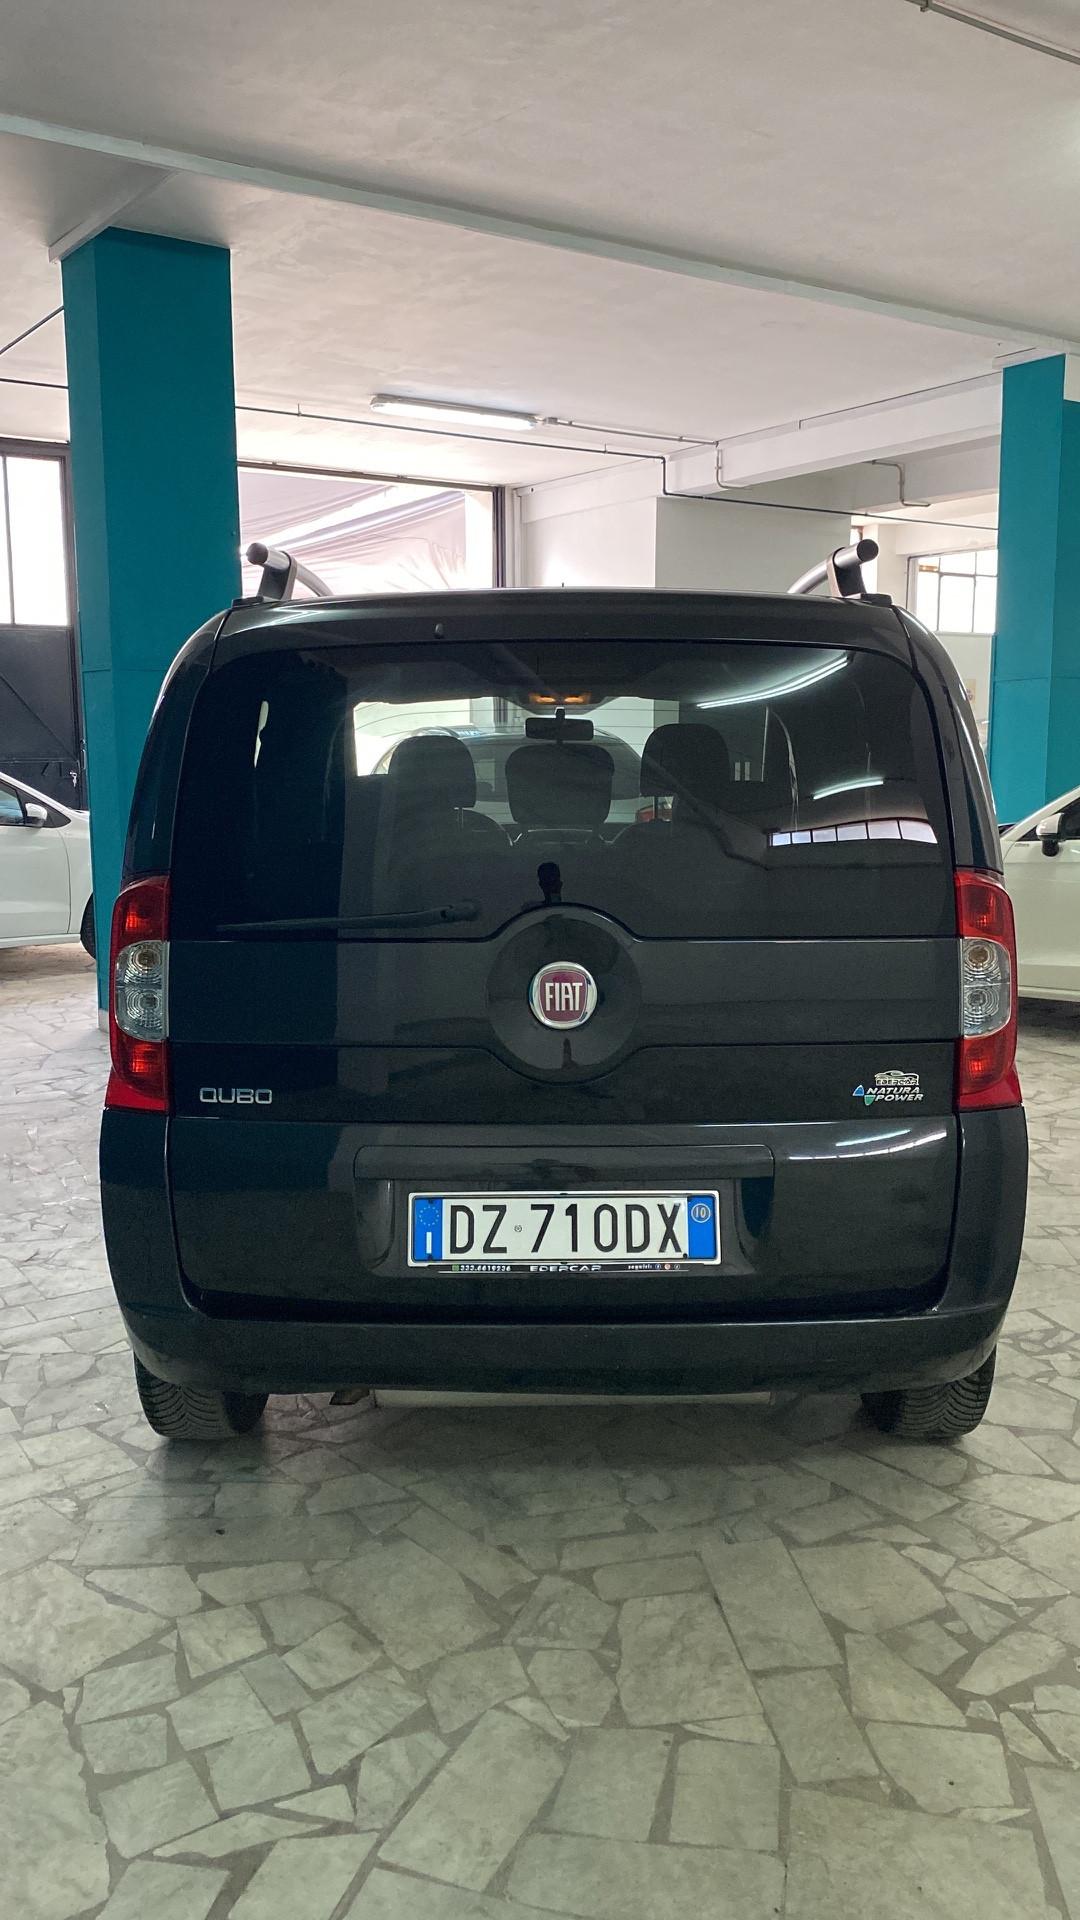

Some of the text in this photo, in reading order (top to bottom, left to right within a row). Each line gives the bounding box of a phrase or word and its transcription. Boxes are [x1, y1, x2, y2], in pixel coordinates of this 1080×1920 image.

[545, 983, 583, 1011] FIAT
[200, 1087, 272, 1104] QUBO
[450, 1204, 507, 1254] DZ
